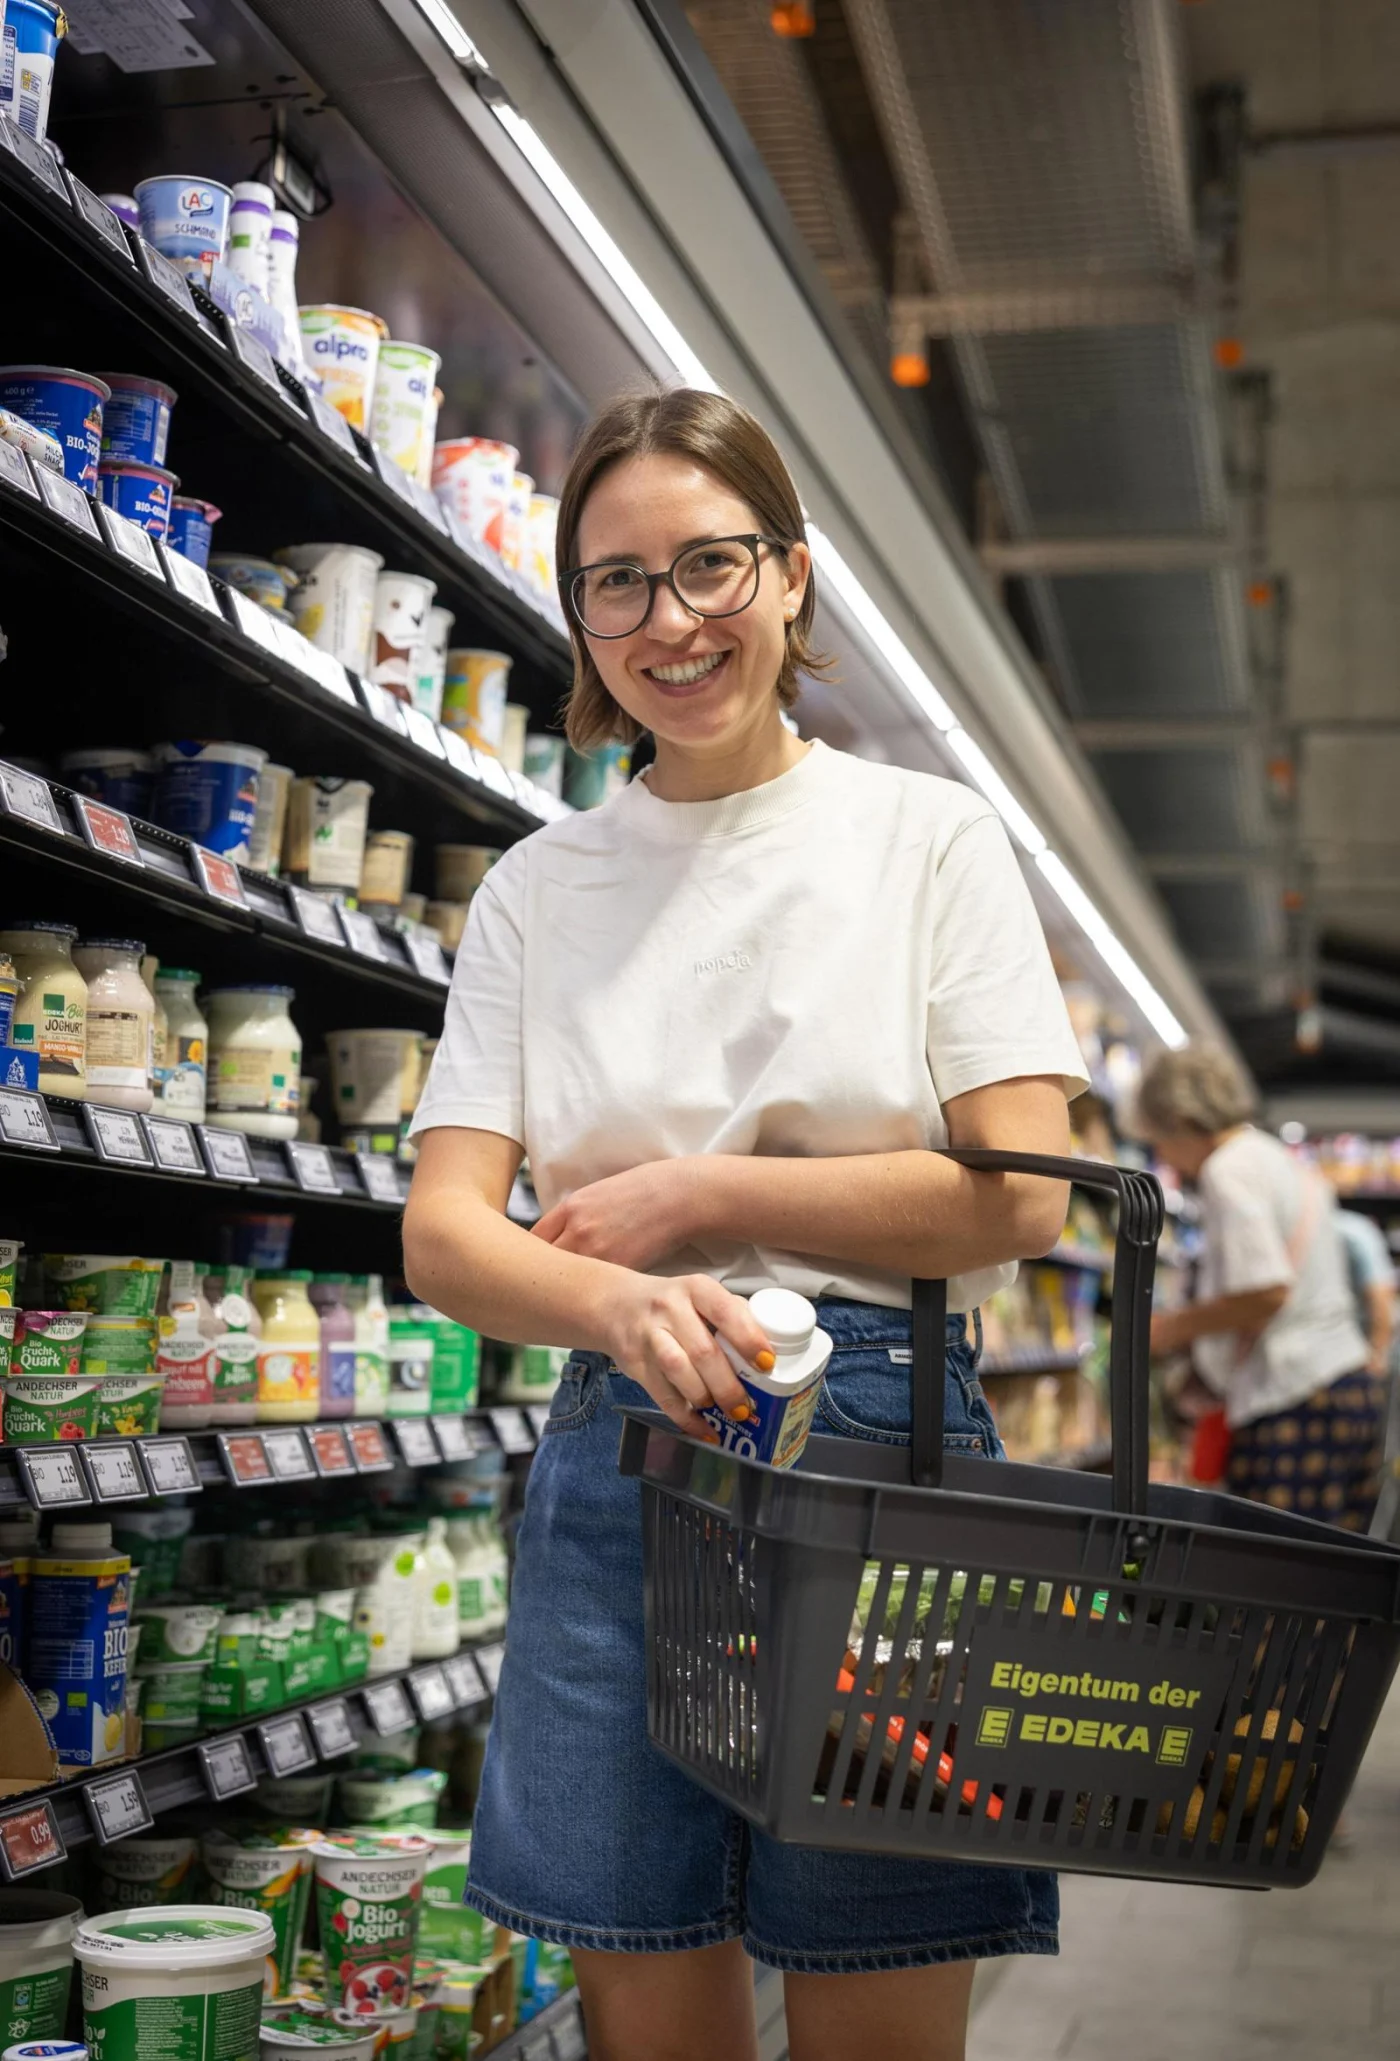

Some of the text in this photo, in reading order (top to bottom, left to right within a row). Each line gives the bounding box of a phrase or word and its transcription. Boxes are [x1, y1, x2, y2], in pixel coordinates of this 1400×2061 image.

[314, 333, 369, 361] alpro
[45, 1019, 83, 1035] JOGHURT
[24, 1108, 45, 1129] 1.19
[50, 1327, 75, 1336] NATUR
[29, 1339, 42, 1347] Bio
[20, 1353, 61, 1370] Quark
[16, 1381, 78, 1392] ANDECHSER
[30, 1391, 64, 1401] NATUR
[10, 1405, 23, 1413] Bio
[4, 1420, 46, 1436] Quark
[33, 1465, 76, 1484] BIO 1.19
[116, 1461, 135, 1479] 1.19
[103, 1628, 128, 1660] BIO
[104, 1658, 127, 1678] KEFIR
[990, 1661, 1201, 1709] Eigentum der
[1019, 1714, 1149, 1752] EDEKA
[1160, 1754, 1183, 1763] EDEKA
[30, 1822, 51, 1845] 0.99
[340, 1869, 418, 1883] ANDECHSER
[358, 1883, 401, 1895] NATUR
[224, 1889, 258, 1909] Bio
[363, 1904, 398, 1924] Bio
[345, 1921, 406, 1944] Jogurt
